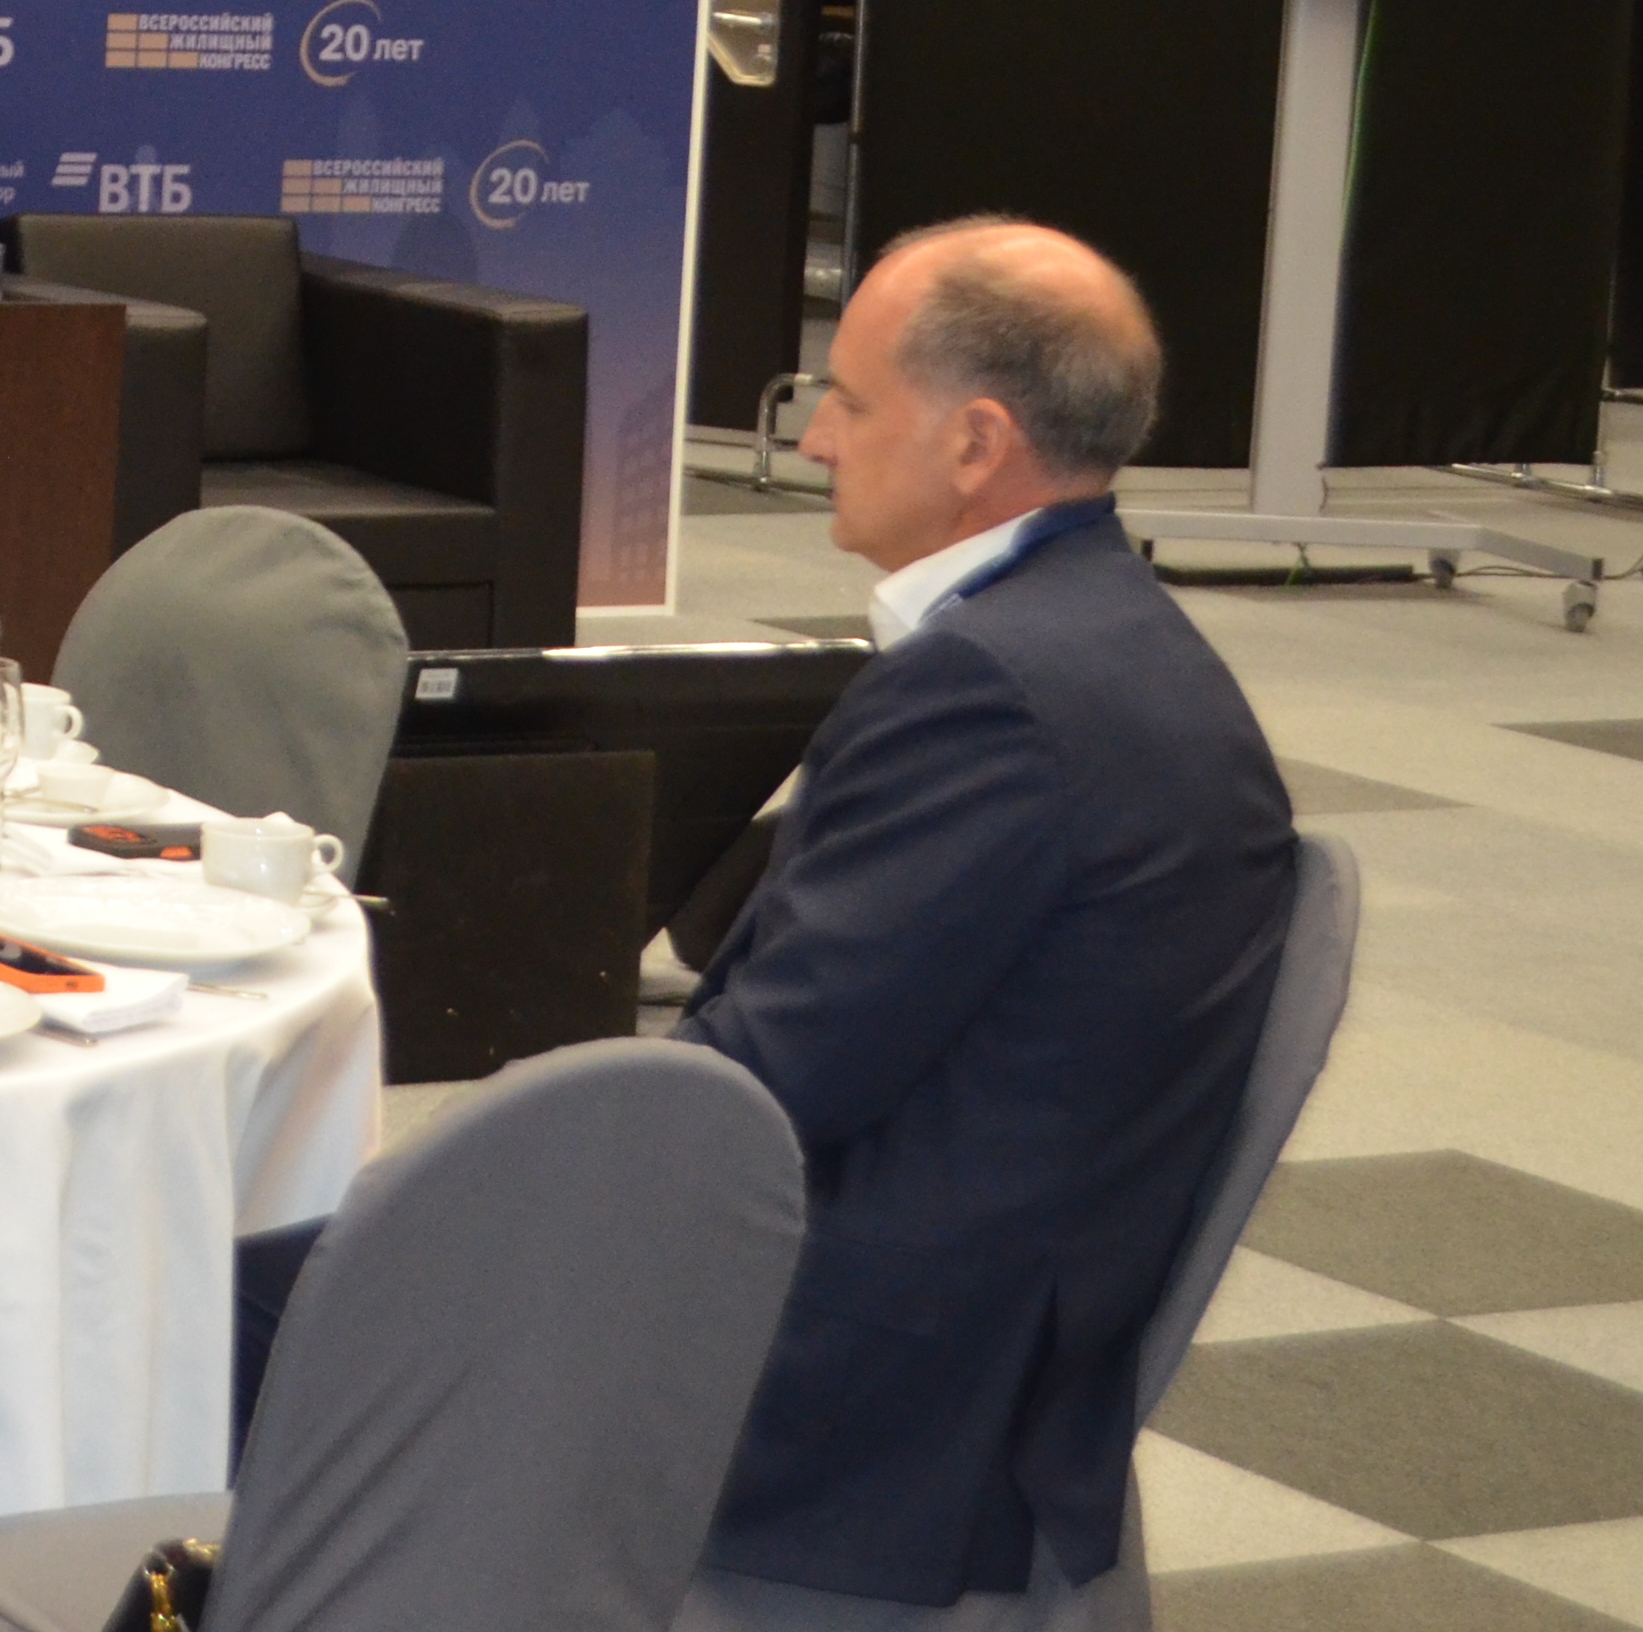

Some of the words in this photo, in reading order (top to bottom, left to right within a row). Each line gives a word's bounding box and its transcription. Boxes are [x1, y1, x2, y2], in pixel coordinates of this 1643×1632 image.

[138, 12, 274, 33] ВСЕРОССИЙСКИЙ
[168, 30, 273, 53] ЖИЛИЩНЫЙ
[318, 23, 370, 62] 20
[373, 36, 425, 63] лет
[198, 50, 272, 71] КОНГРЕСС
[312, 157, 445, 178] ВСЕРОССИЙСКИЙ
[97, 164, 193, 214] ВТБ
[341, 176, 444, 197] ЖИЛИЩНЫЙ
[487, 168, 538, 205] 20
[540, 179, 591, 205] лет
[371, 195, 442, 215] КОНГРЕСС
